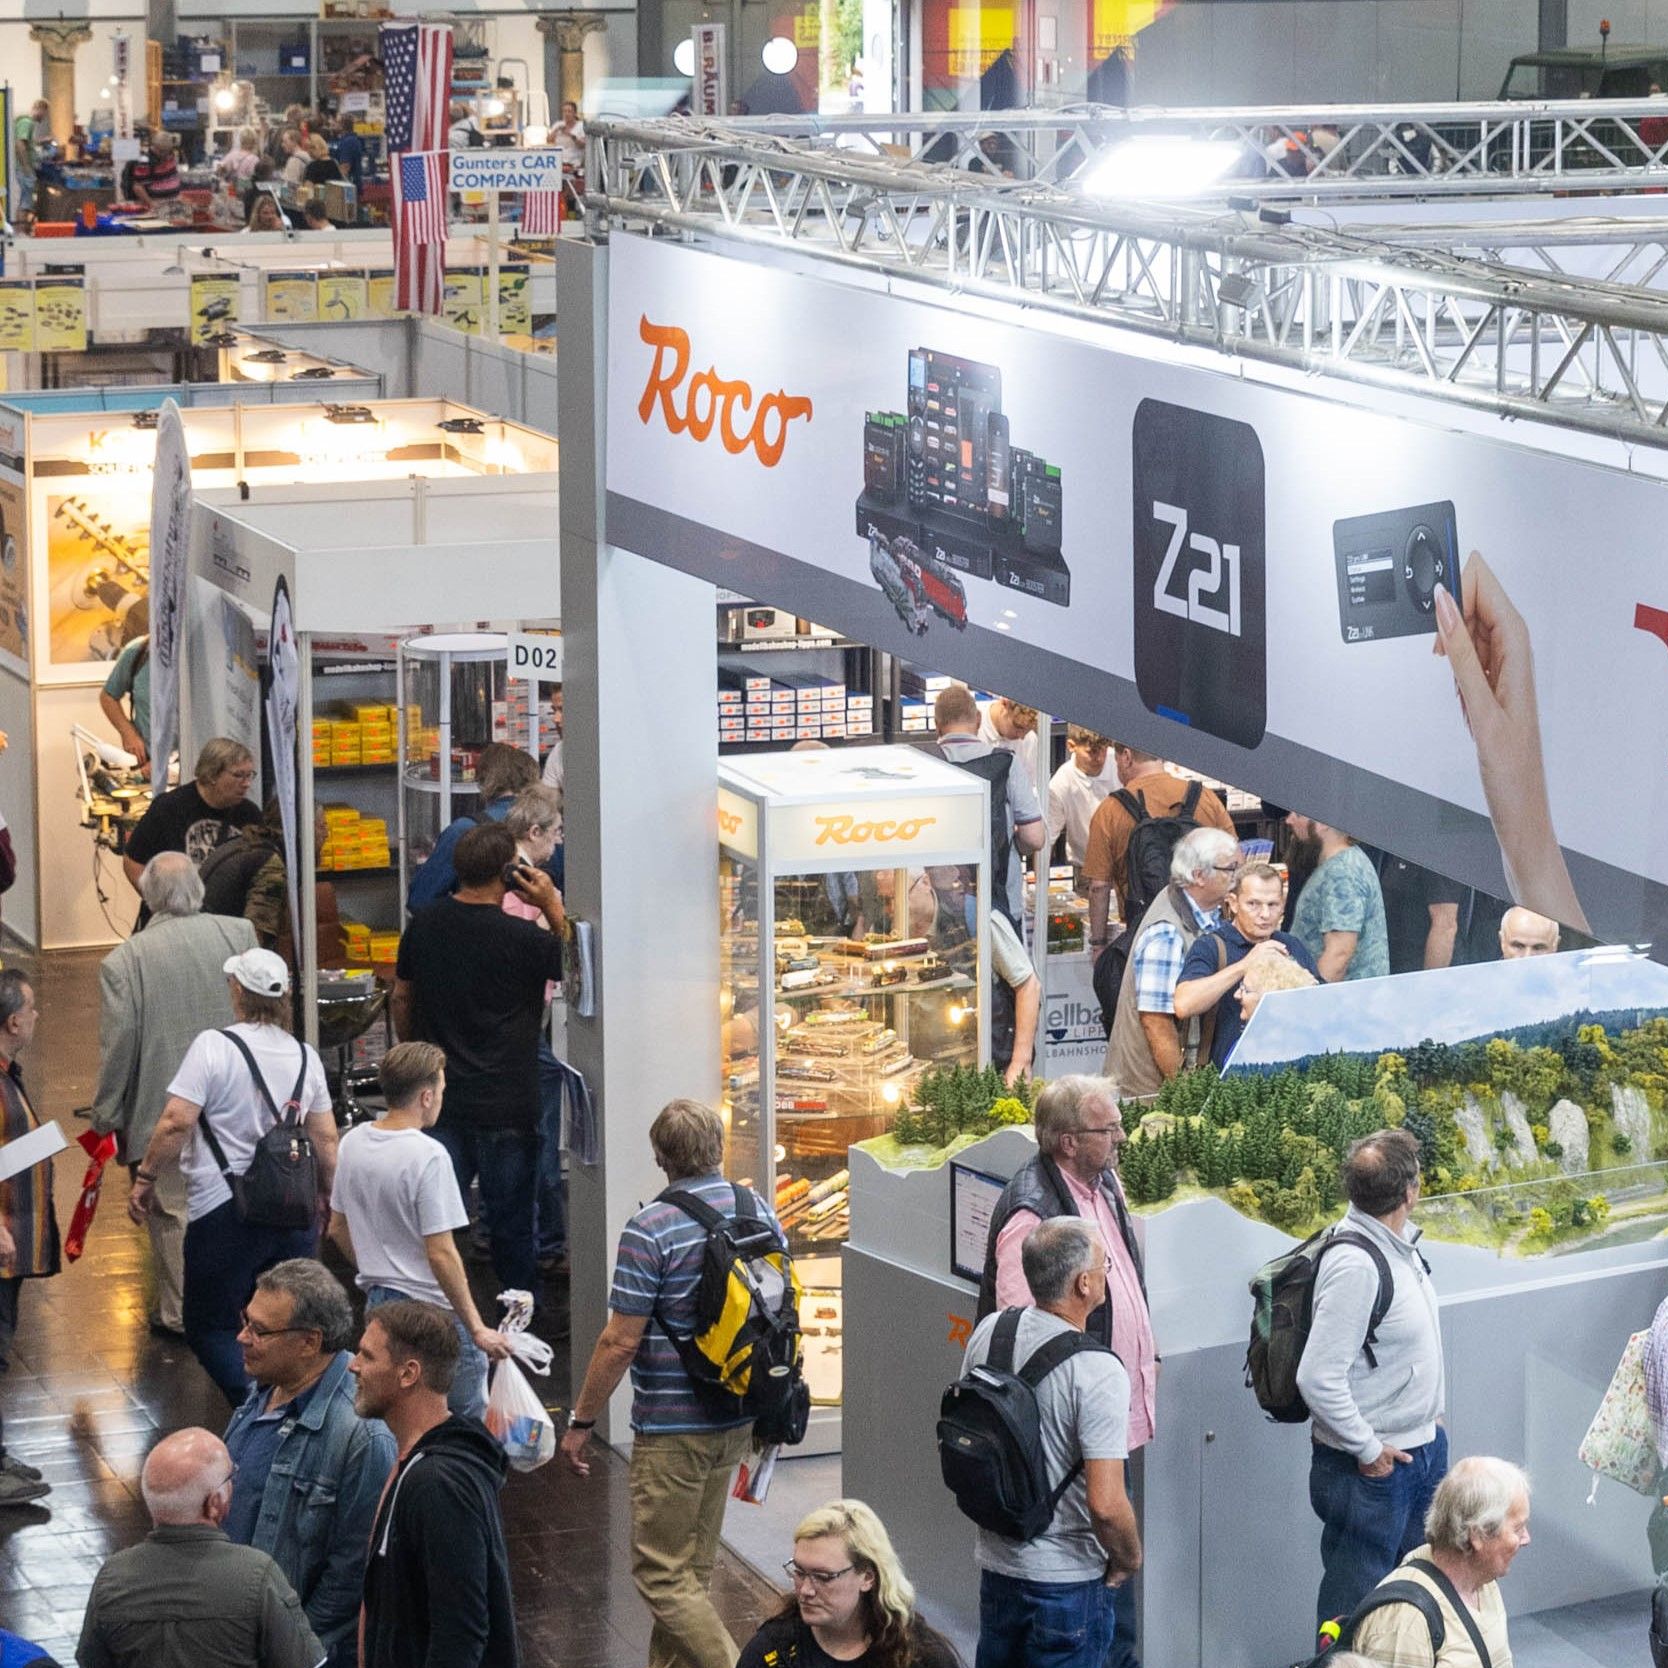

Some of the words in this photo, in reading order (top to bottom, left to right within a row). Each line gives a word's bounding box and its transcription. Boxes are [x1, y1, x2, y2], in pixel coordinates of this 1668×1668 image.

[521, 156, 557, 169] CAR
[453, 174, 543, 188] COMPANY
[638, 313, 813, 467] Roco
[1153, 500, 1240, 637] Z21
[515, 645, 557, 669] D02
[815, 814, 936, 846] Roco
